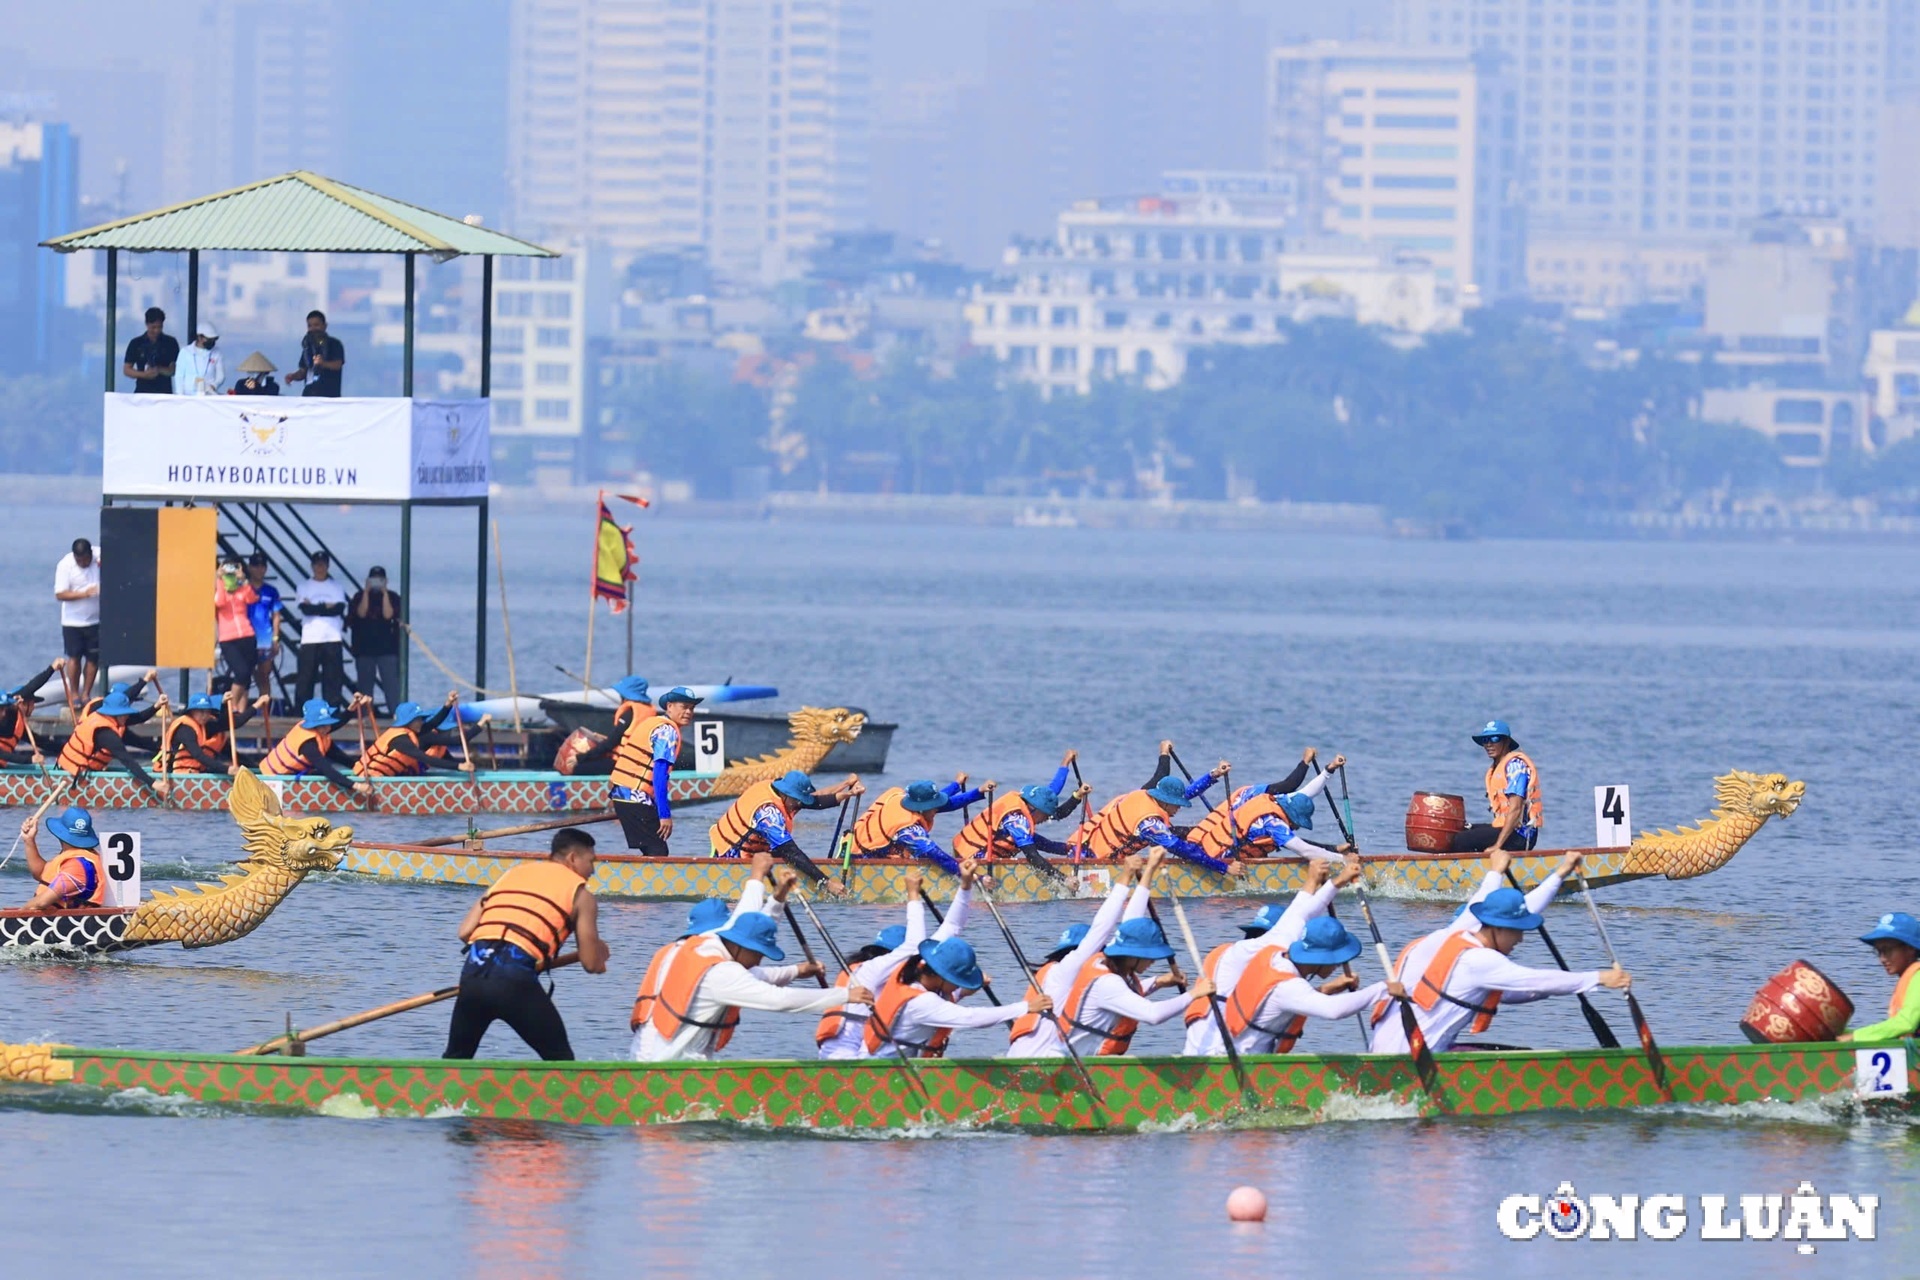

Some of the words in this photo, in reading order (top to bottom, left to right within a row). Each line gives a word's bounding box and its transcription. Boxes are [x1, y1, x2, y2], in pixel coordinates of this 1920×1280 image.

[168, 465, 357, 485] HOTAYBOATCLUB.VN
[701, 724, 719, 755] 5
[549, 781, 567, 808] 5
[1602, 787, 1625, 825] 4
[108, 833, 135, 881] 3
[1872, 1052, 1893, 1091] 2
